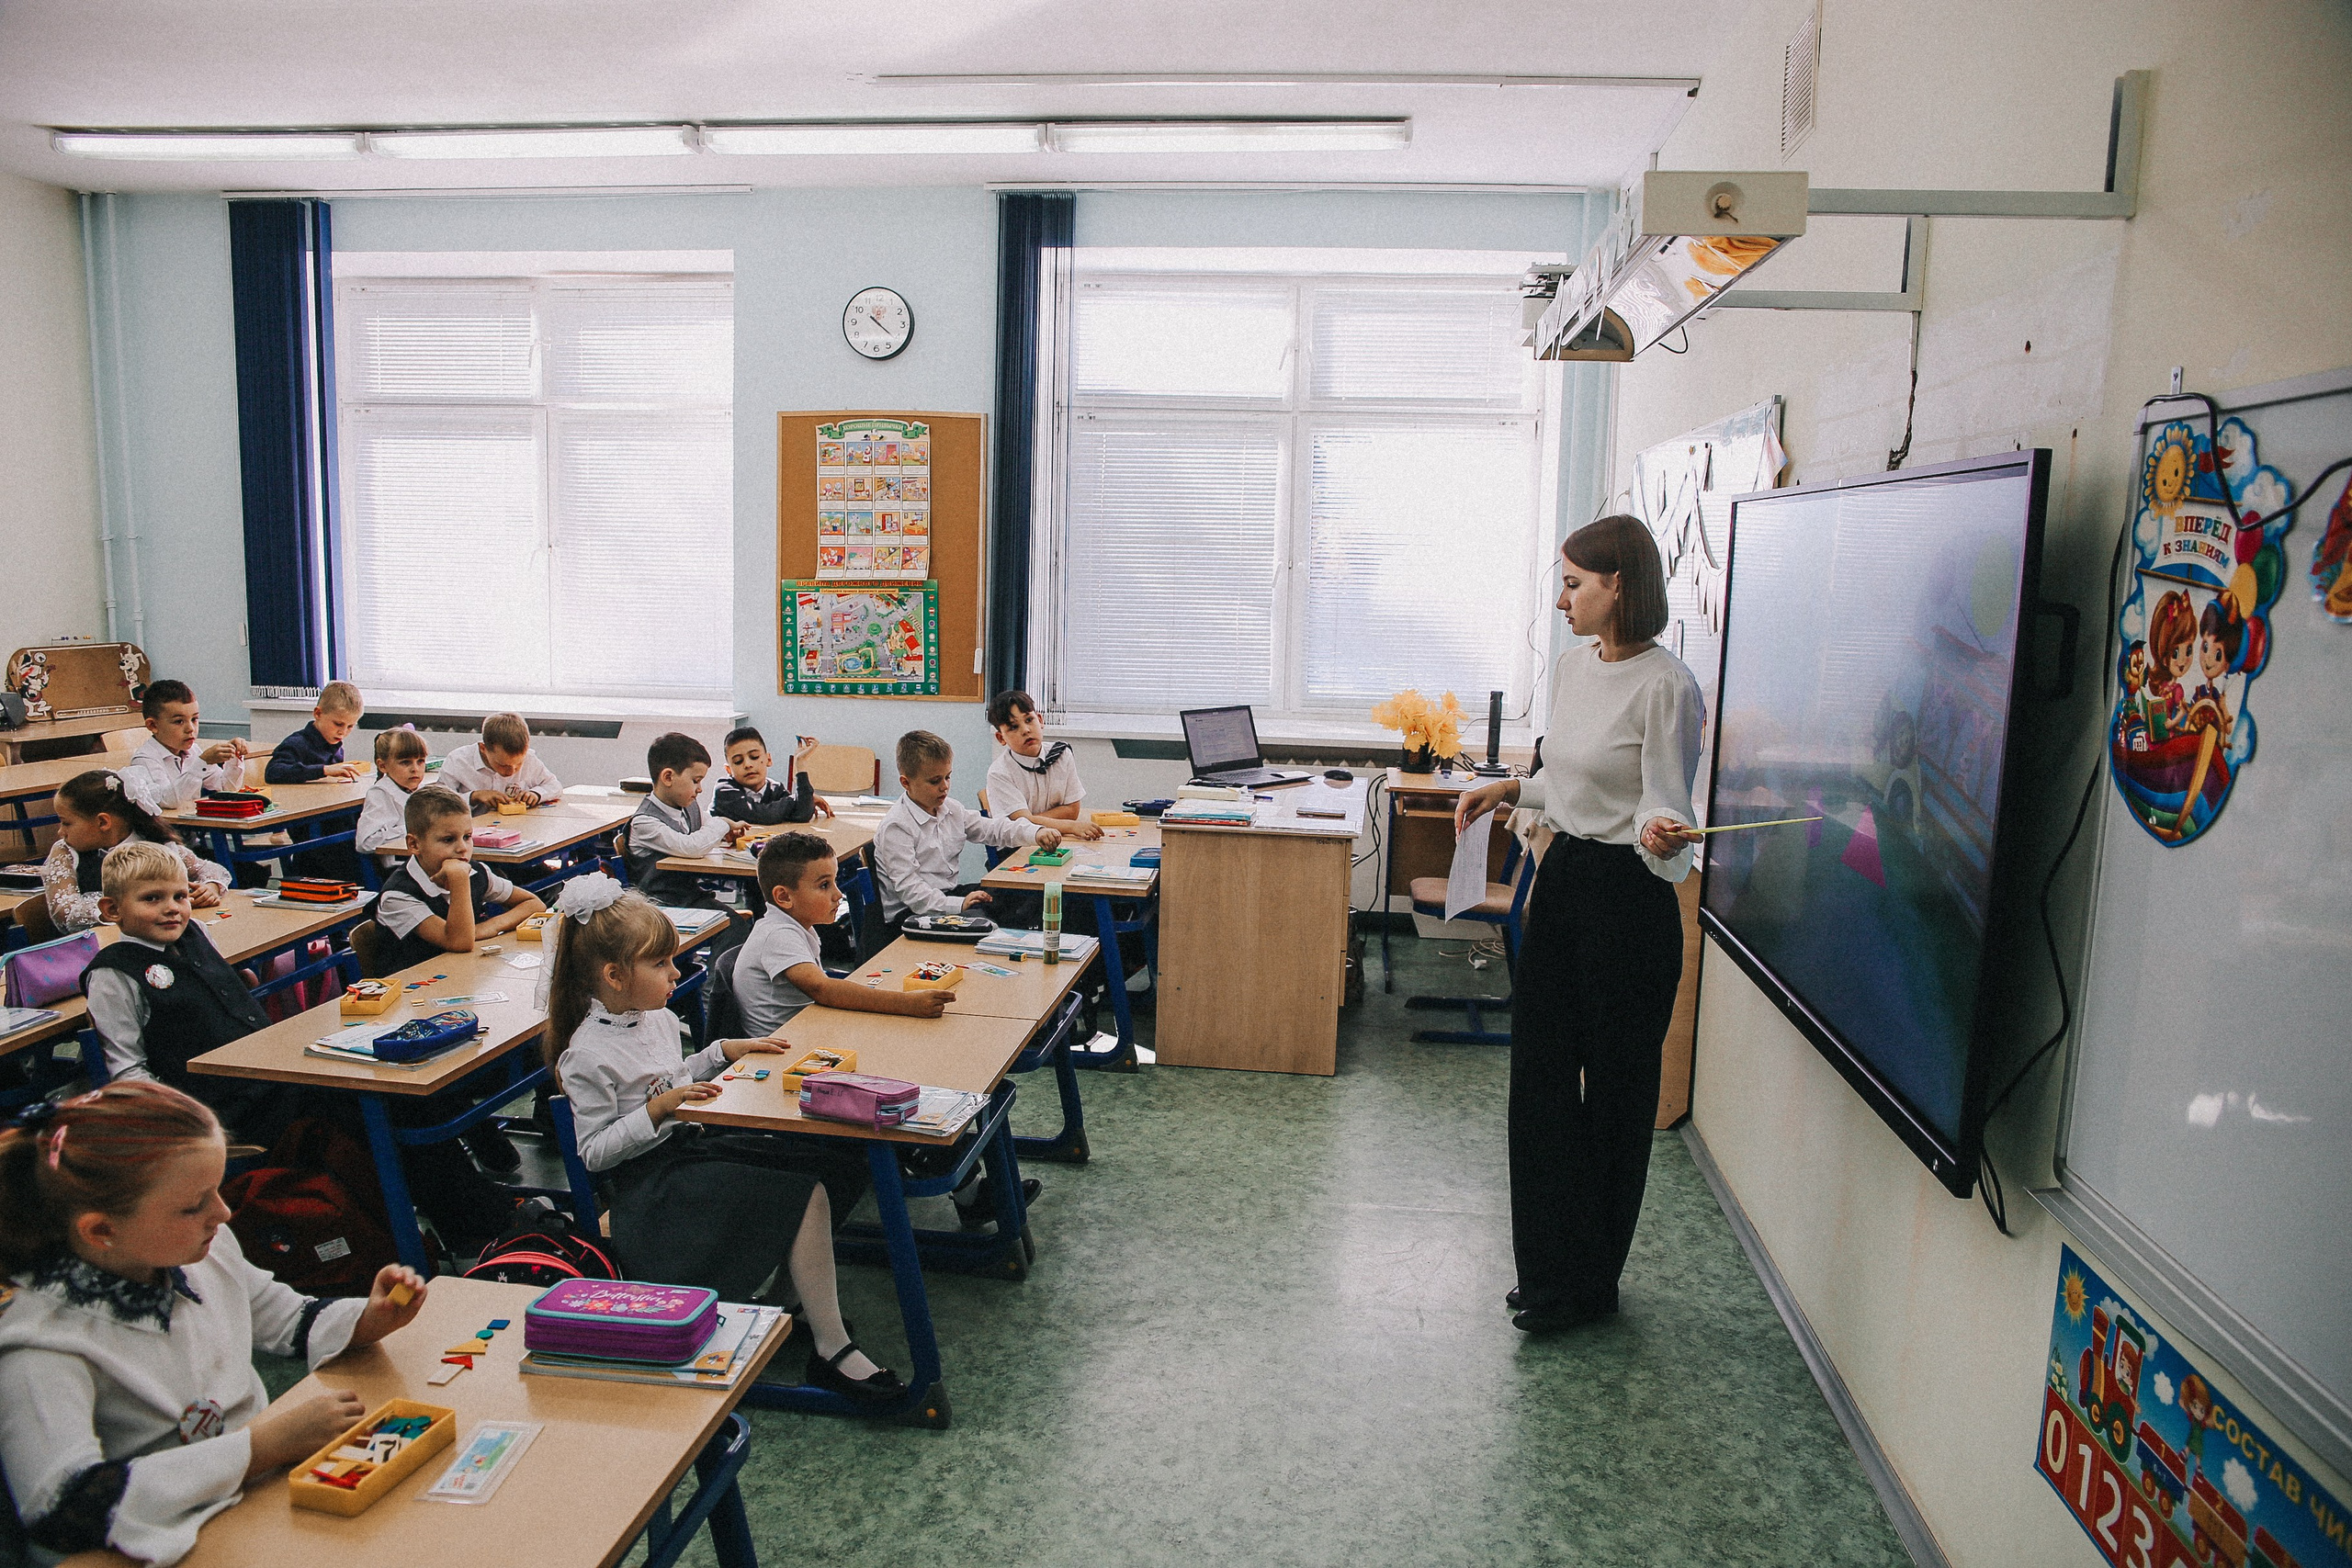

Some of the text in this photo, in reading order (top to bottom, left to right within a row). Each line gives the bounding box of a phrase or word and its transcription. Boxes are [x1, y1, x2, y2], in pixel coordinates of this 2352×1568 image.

[2175, 516, 2232, 545] ВПЕРЁД
[2164, 540, 2230, 569] К ЗНАНИЯМ
[379, 1439, 397, 1462] 7
[2046, 1410, 2067, 1473] 0
[2161, 1443, 2165, 1459] 1
[2211, 1404, 2301, 1505] СОСТАВ
[2078, 1444, 2092, 1511] 1
[2097, 1471, 2121, 1553] 2
[2215, 1495, 2224, 1513] 2
[2126, 1505, 2154, 1568] 3
